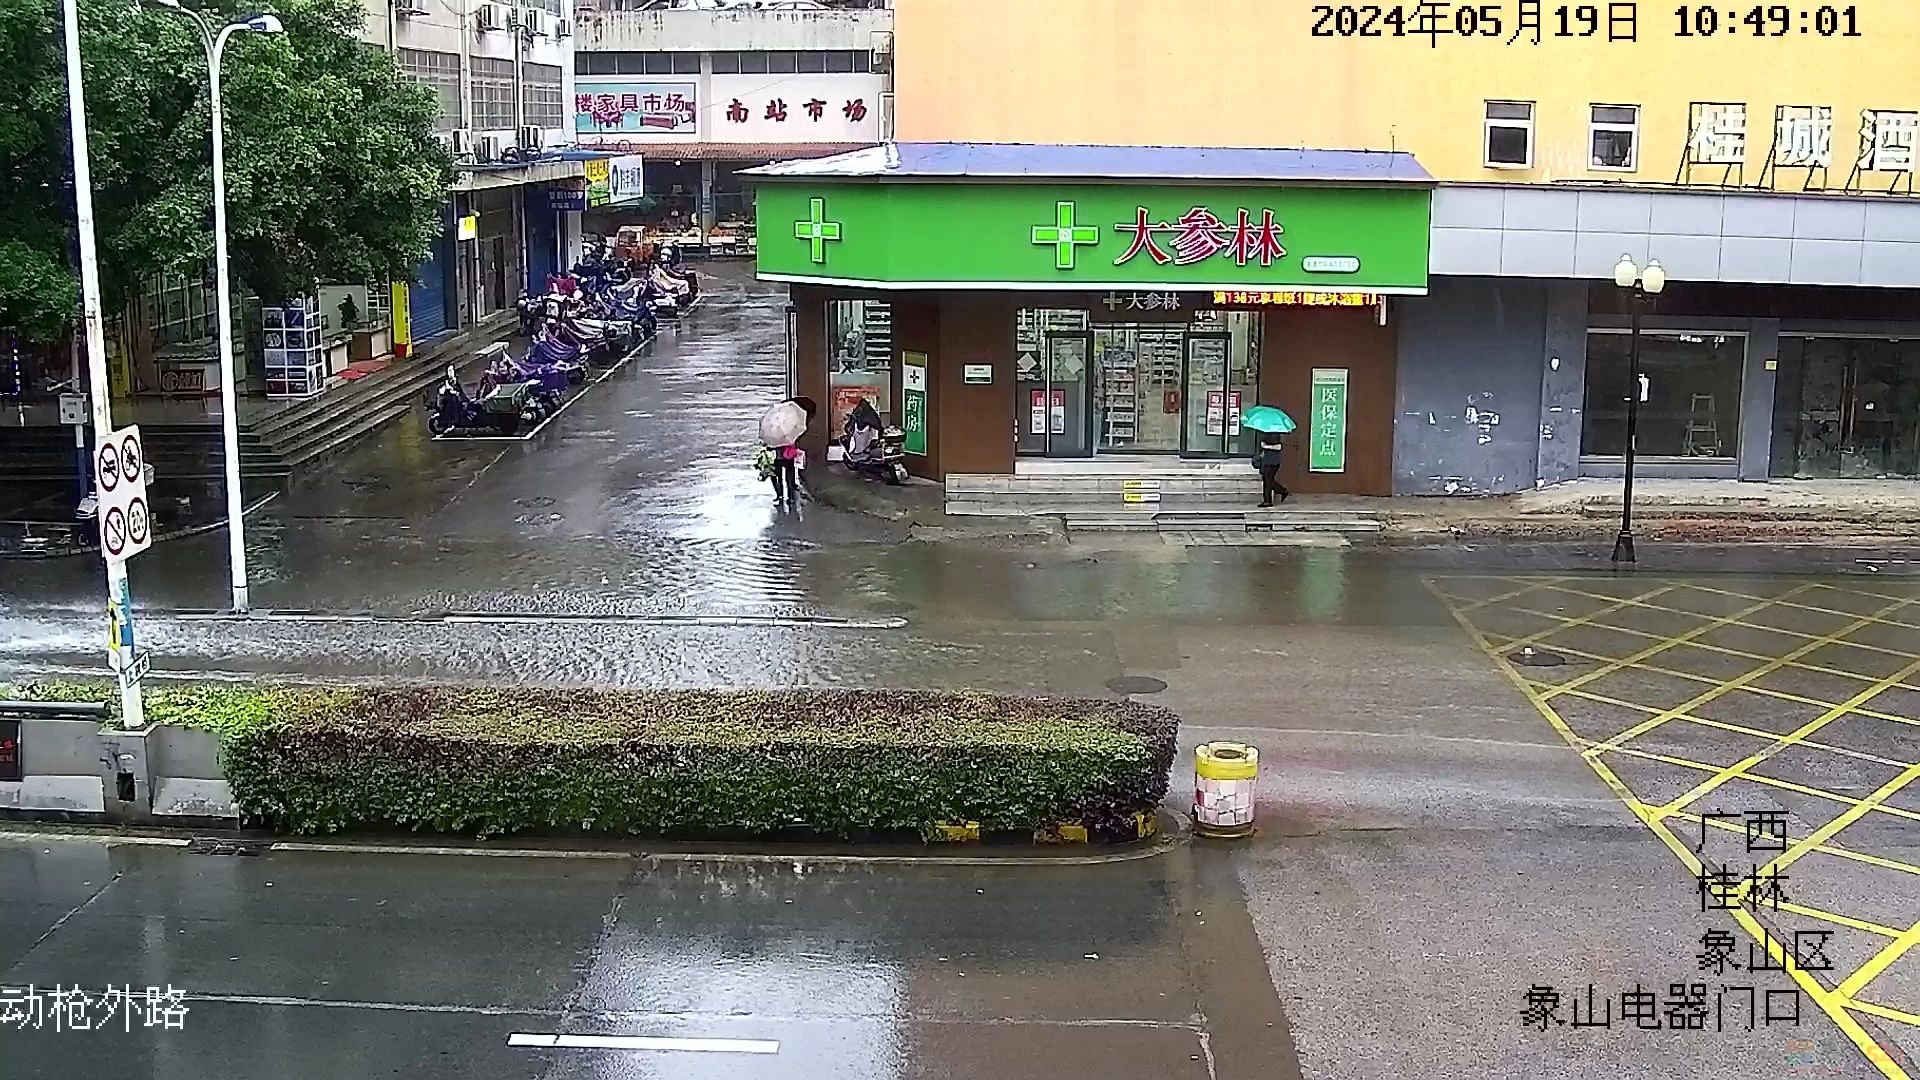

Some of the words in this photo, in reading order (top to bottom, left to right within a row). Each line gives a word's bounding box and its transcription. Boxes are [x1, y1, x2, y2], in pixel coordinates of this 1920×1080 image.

[726, 98, 867, 123] 南站市场
[1688, 103, 1920, 171] 桂城酒
[1113, 206, 1287, 266] 大参林
[1125, 292, 1181, 310] 大参林
[906, 394, 921, 432] 药房
[1321, 387, 1338, 456] 医保定点
